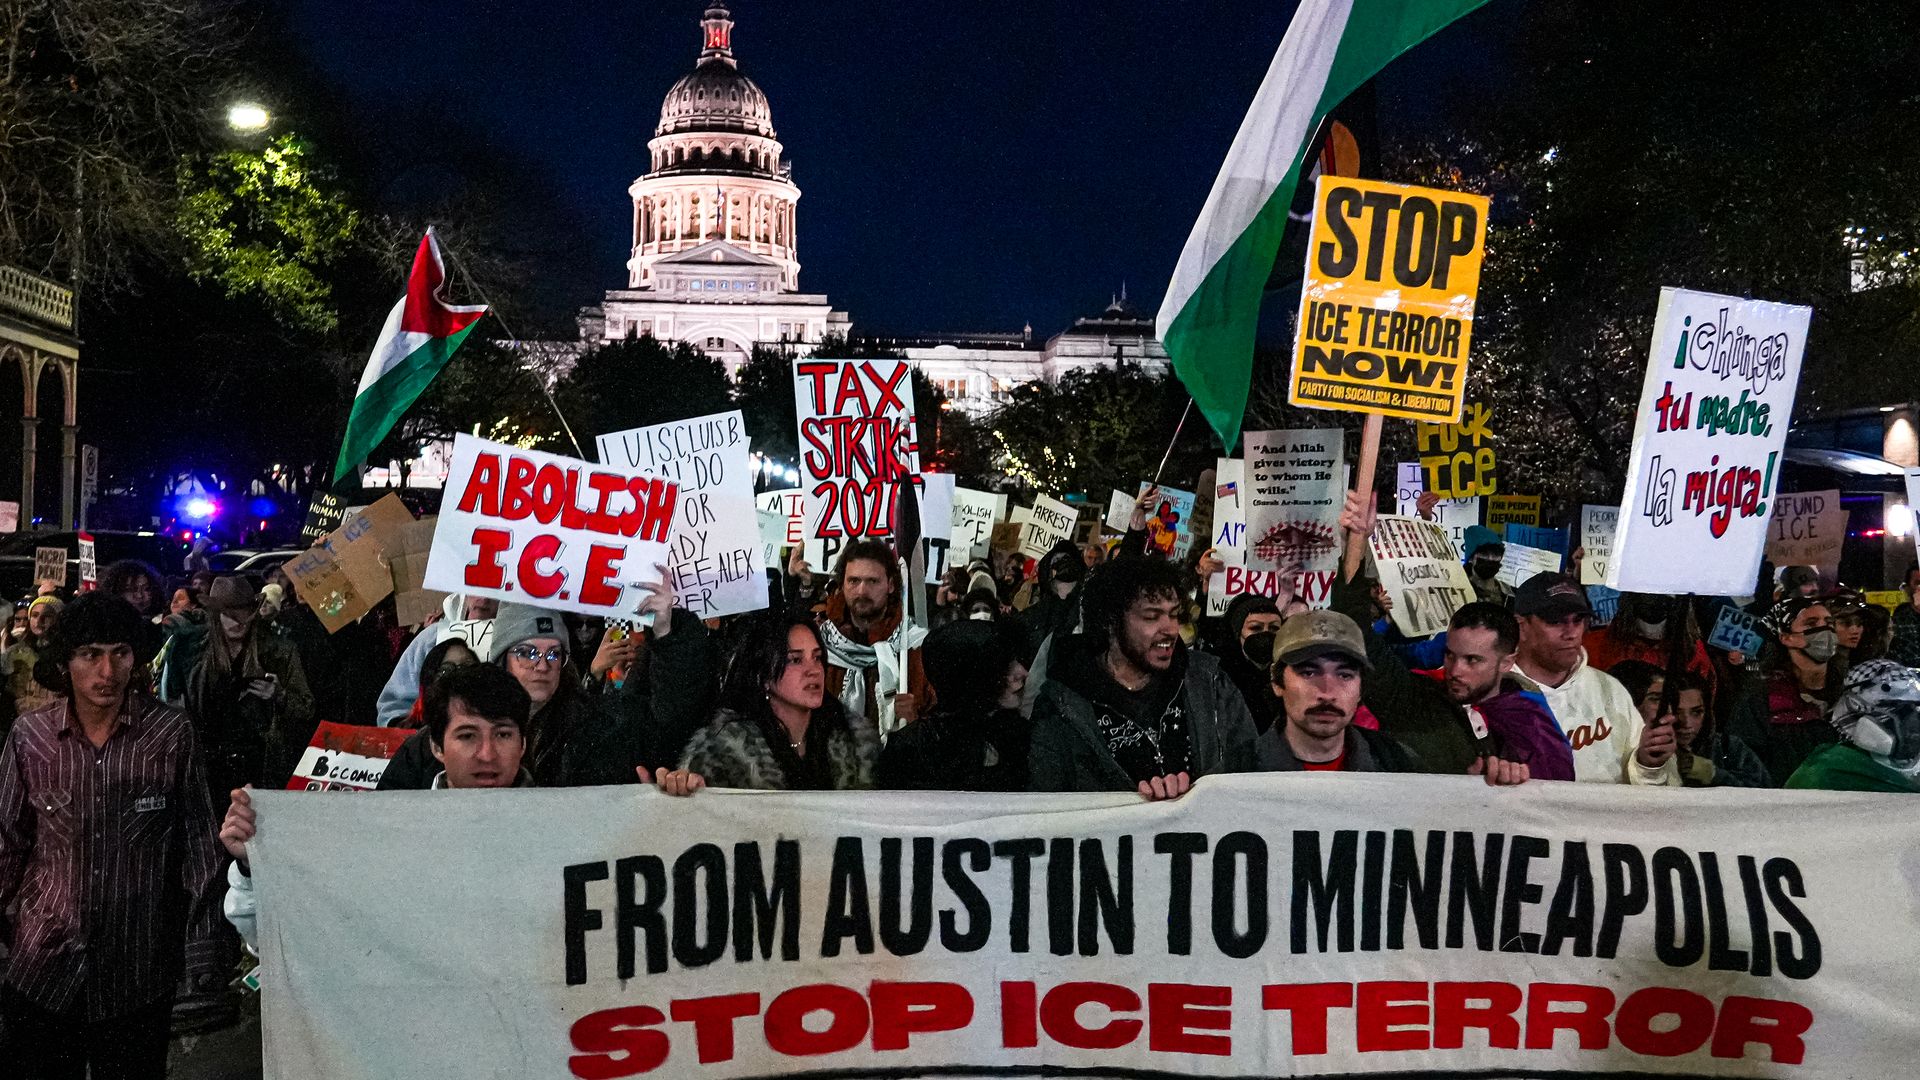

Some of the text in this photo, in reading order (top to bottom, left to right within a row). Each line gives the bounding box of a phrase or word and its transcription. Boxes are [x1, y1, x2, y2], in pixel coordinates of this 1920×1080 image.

[1318, 186, 1477, 290] STOP
[1306, 301, 1462, 359] ICE TERROR
[1302, 346, 1458, 389] NOW!
[797, 361, 909, 418] TAX
[1300, 381, 1451, 412] PARTY FOR SOCIALISM & LIBERATION
[1655, 381, 1693, 433] tu
[1253, 443, 1325, 454] "And Allah
[1254, 458, 1336, 470] gives victory
[1255, 471, 1332, 481] to whom He
[322, 493, 337, 506] NO
[456, 450, 681, 544] ABOLISH
[1491, 501, 1537, 511] THE PEOPLE
[1644, 451, 1778, 539] la migra!
[309, 503, 343, 520] HUMAN
[318, 517, 328, 527] IS
[961, 504, 993, 520] OLISH
[1033, 503, 1074, 533] ARREST
[1490, 513, 1536, 525] DEMAND
[564, 829, 1823, 985] FROM AUSTIN TO MINNEAPOLIS
[567, 980, 1814, 1080] STOP ICE TERROR
